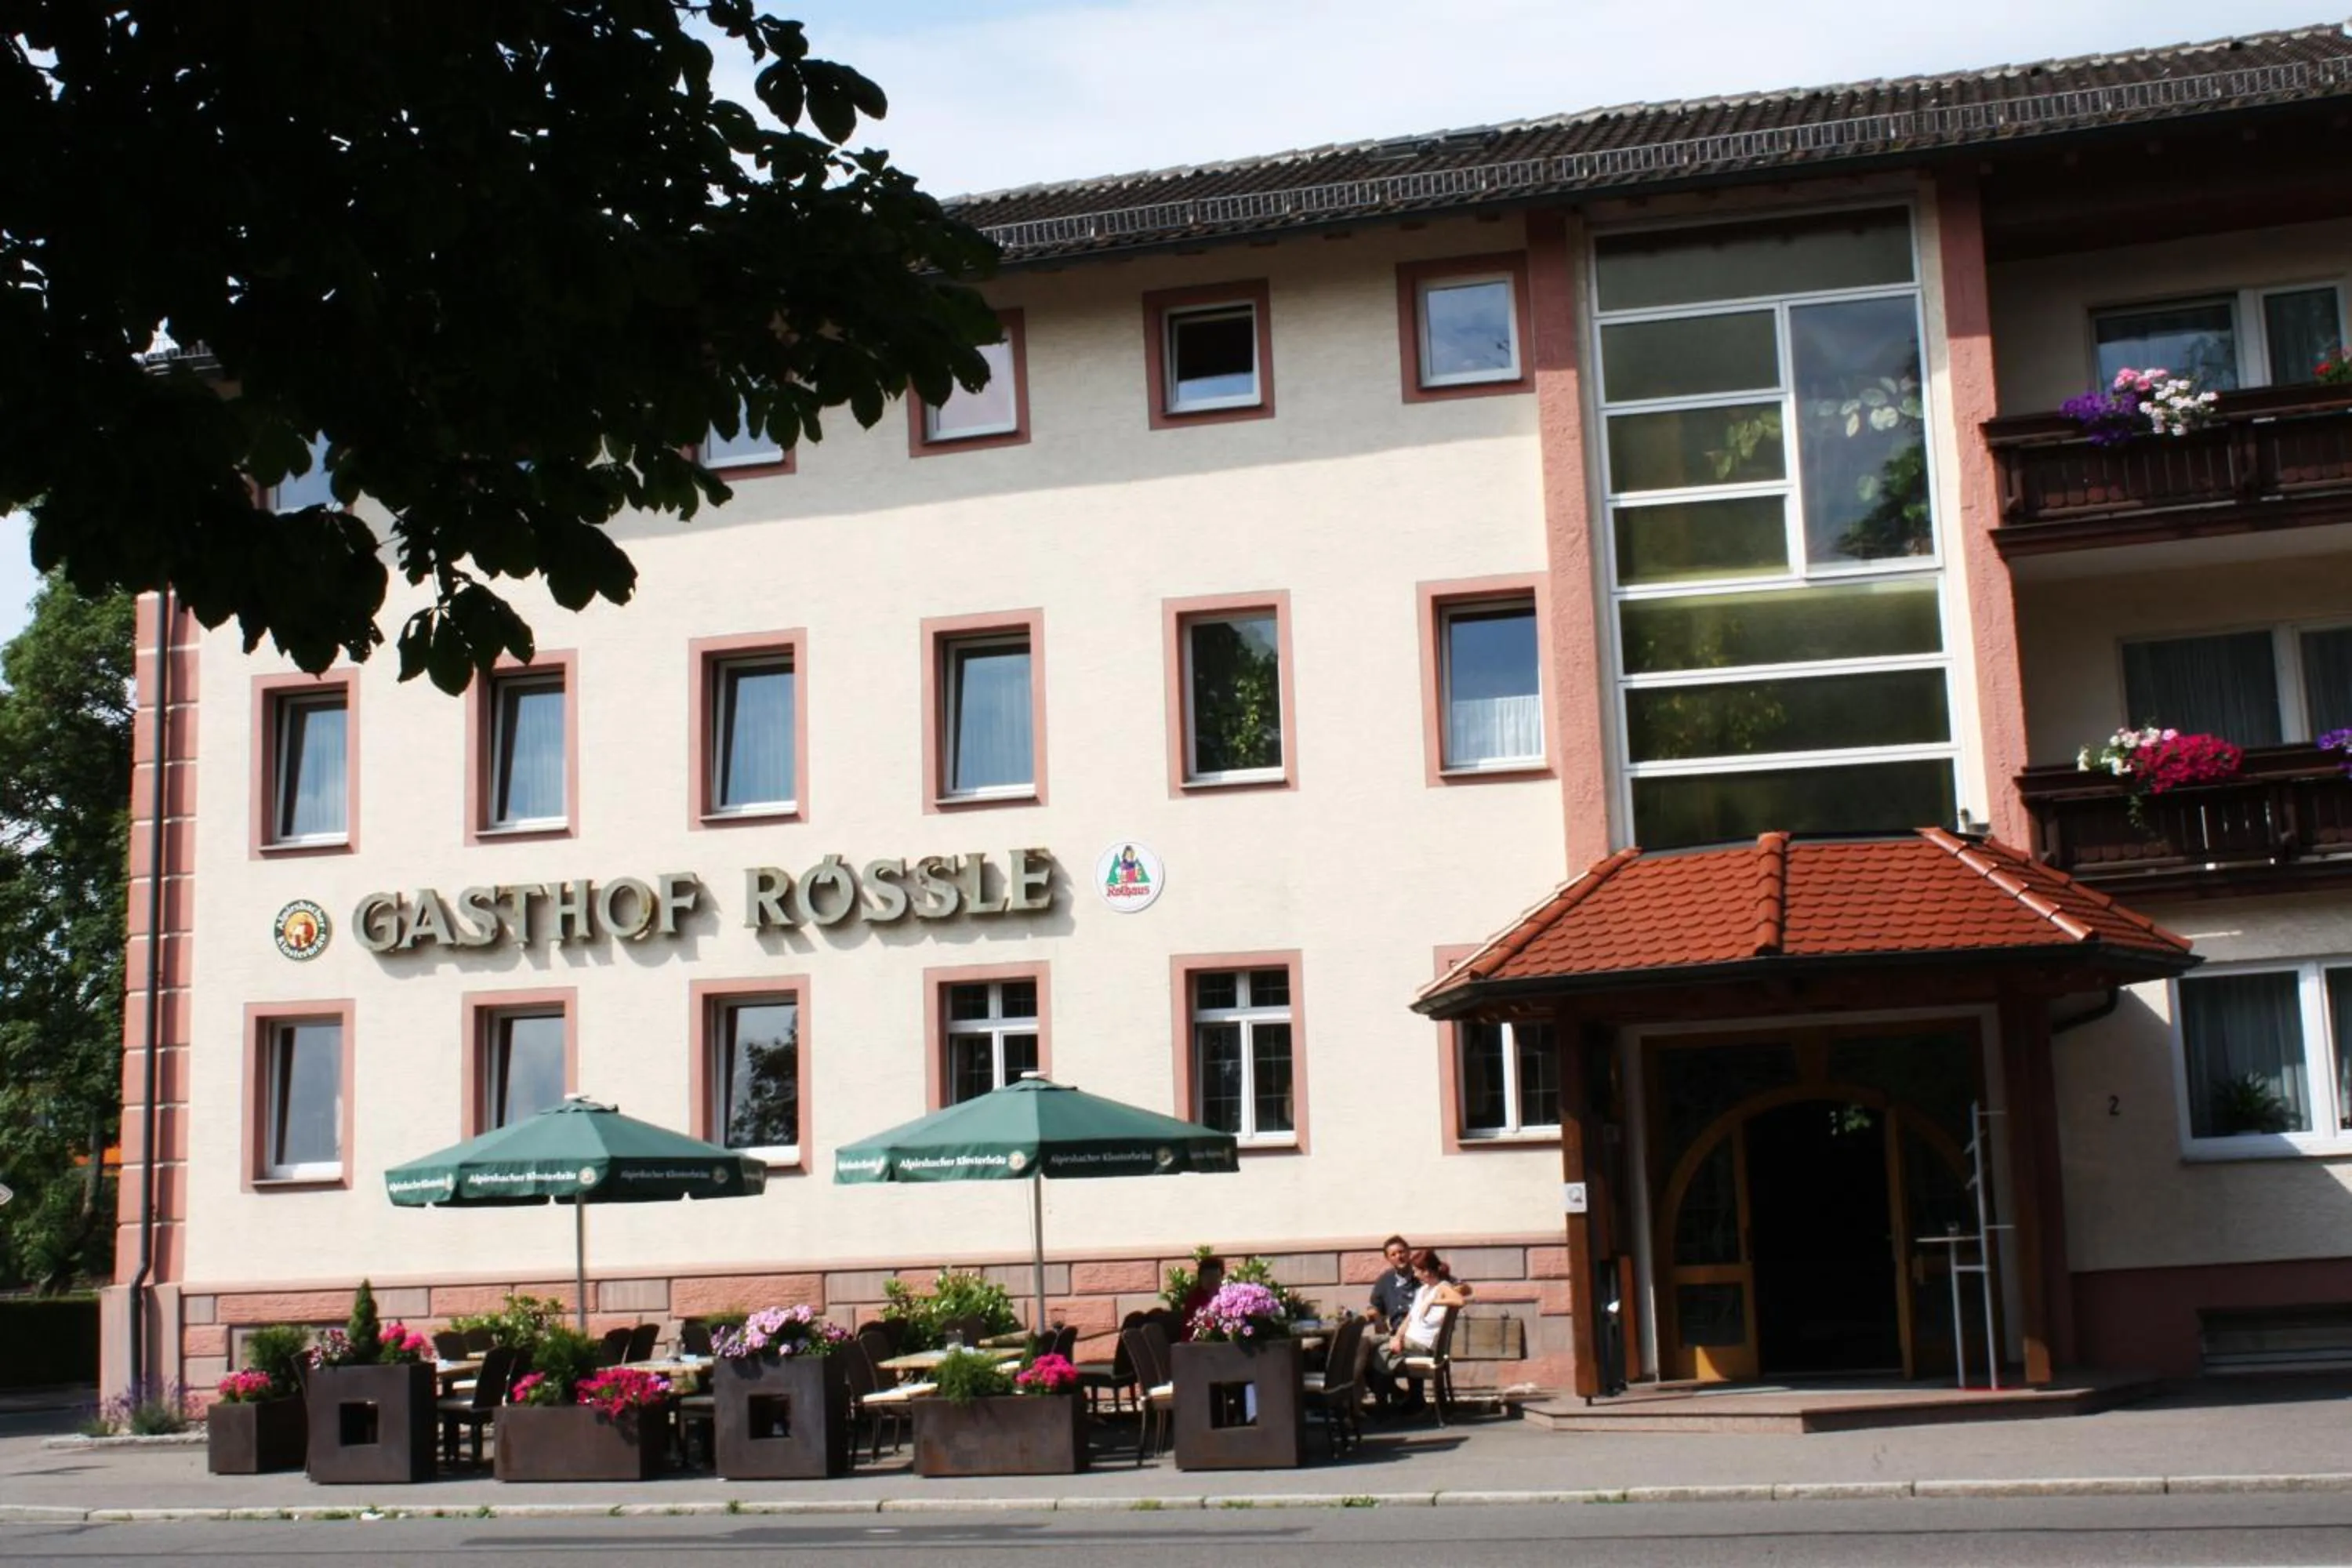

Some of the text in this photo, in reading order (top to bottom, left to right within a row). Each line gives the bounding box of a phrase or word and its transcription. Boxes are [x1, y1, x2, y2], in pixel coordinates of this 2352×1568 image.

[352, 848, 1054, 953] GASTHOF RÖSSLE
[1106, 885, 1149, 898] Rothaus
[2108, 1094, 2120, 1116] 2
